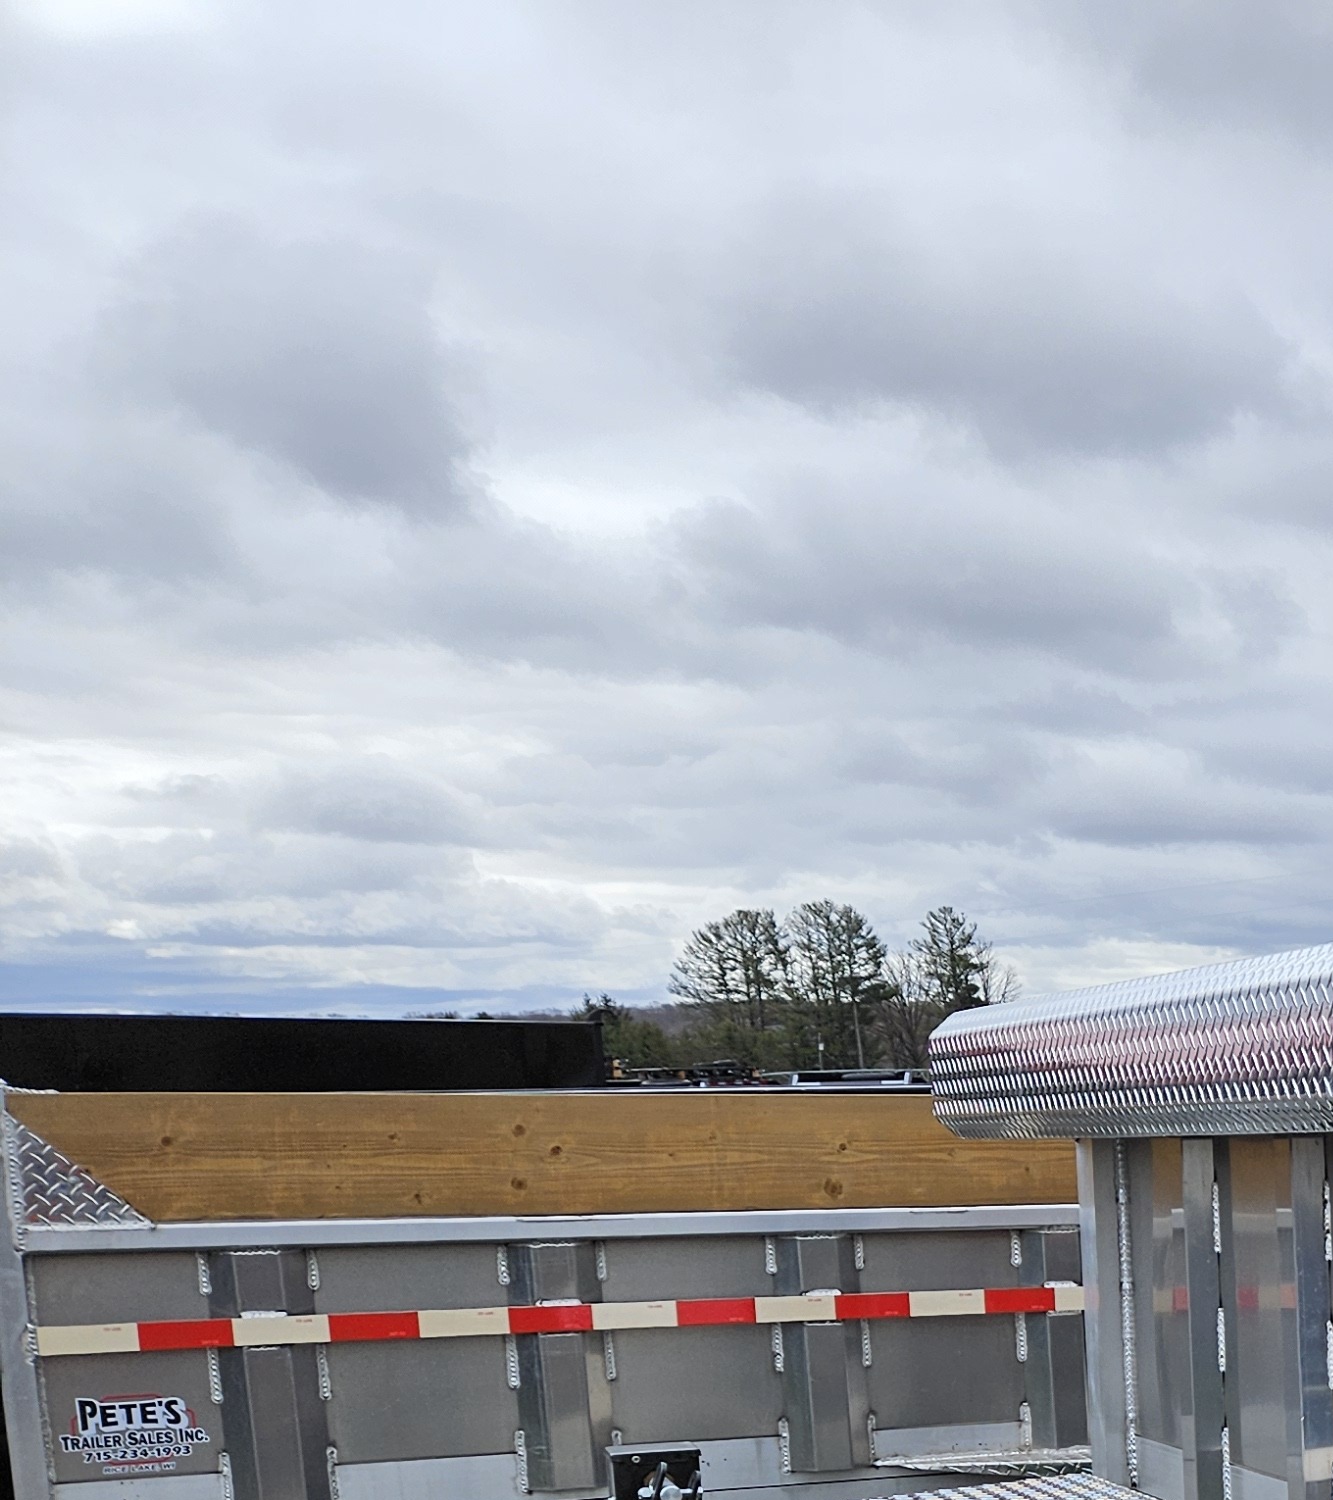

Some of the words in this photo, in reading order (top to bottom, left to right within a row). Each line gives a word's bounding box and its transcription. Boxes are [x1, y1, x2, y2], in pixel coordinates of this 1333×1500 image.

[77, 1399, 182, 1432] PETE'S
[60, 1435, 122, 1451] TRAILER
[128, 1431, 173, 1446] SALES
[179, 1428, 209, 1442] INC.
[84, 1445, 192, 1462] 715-234-1993
[103, 1465, 127, 1474] RICE
